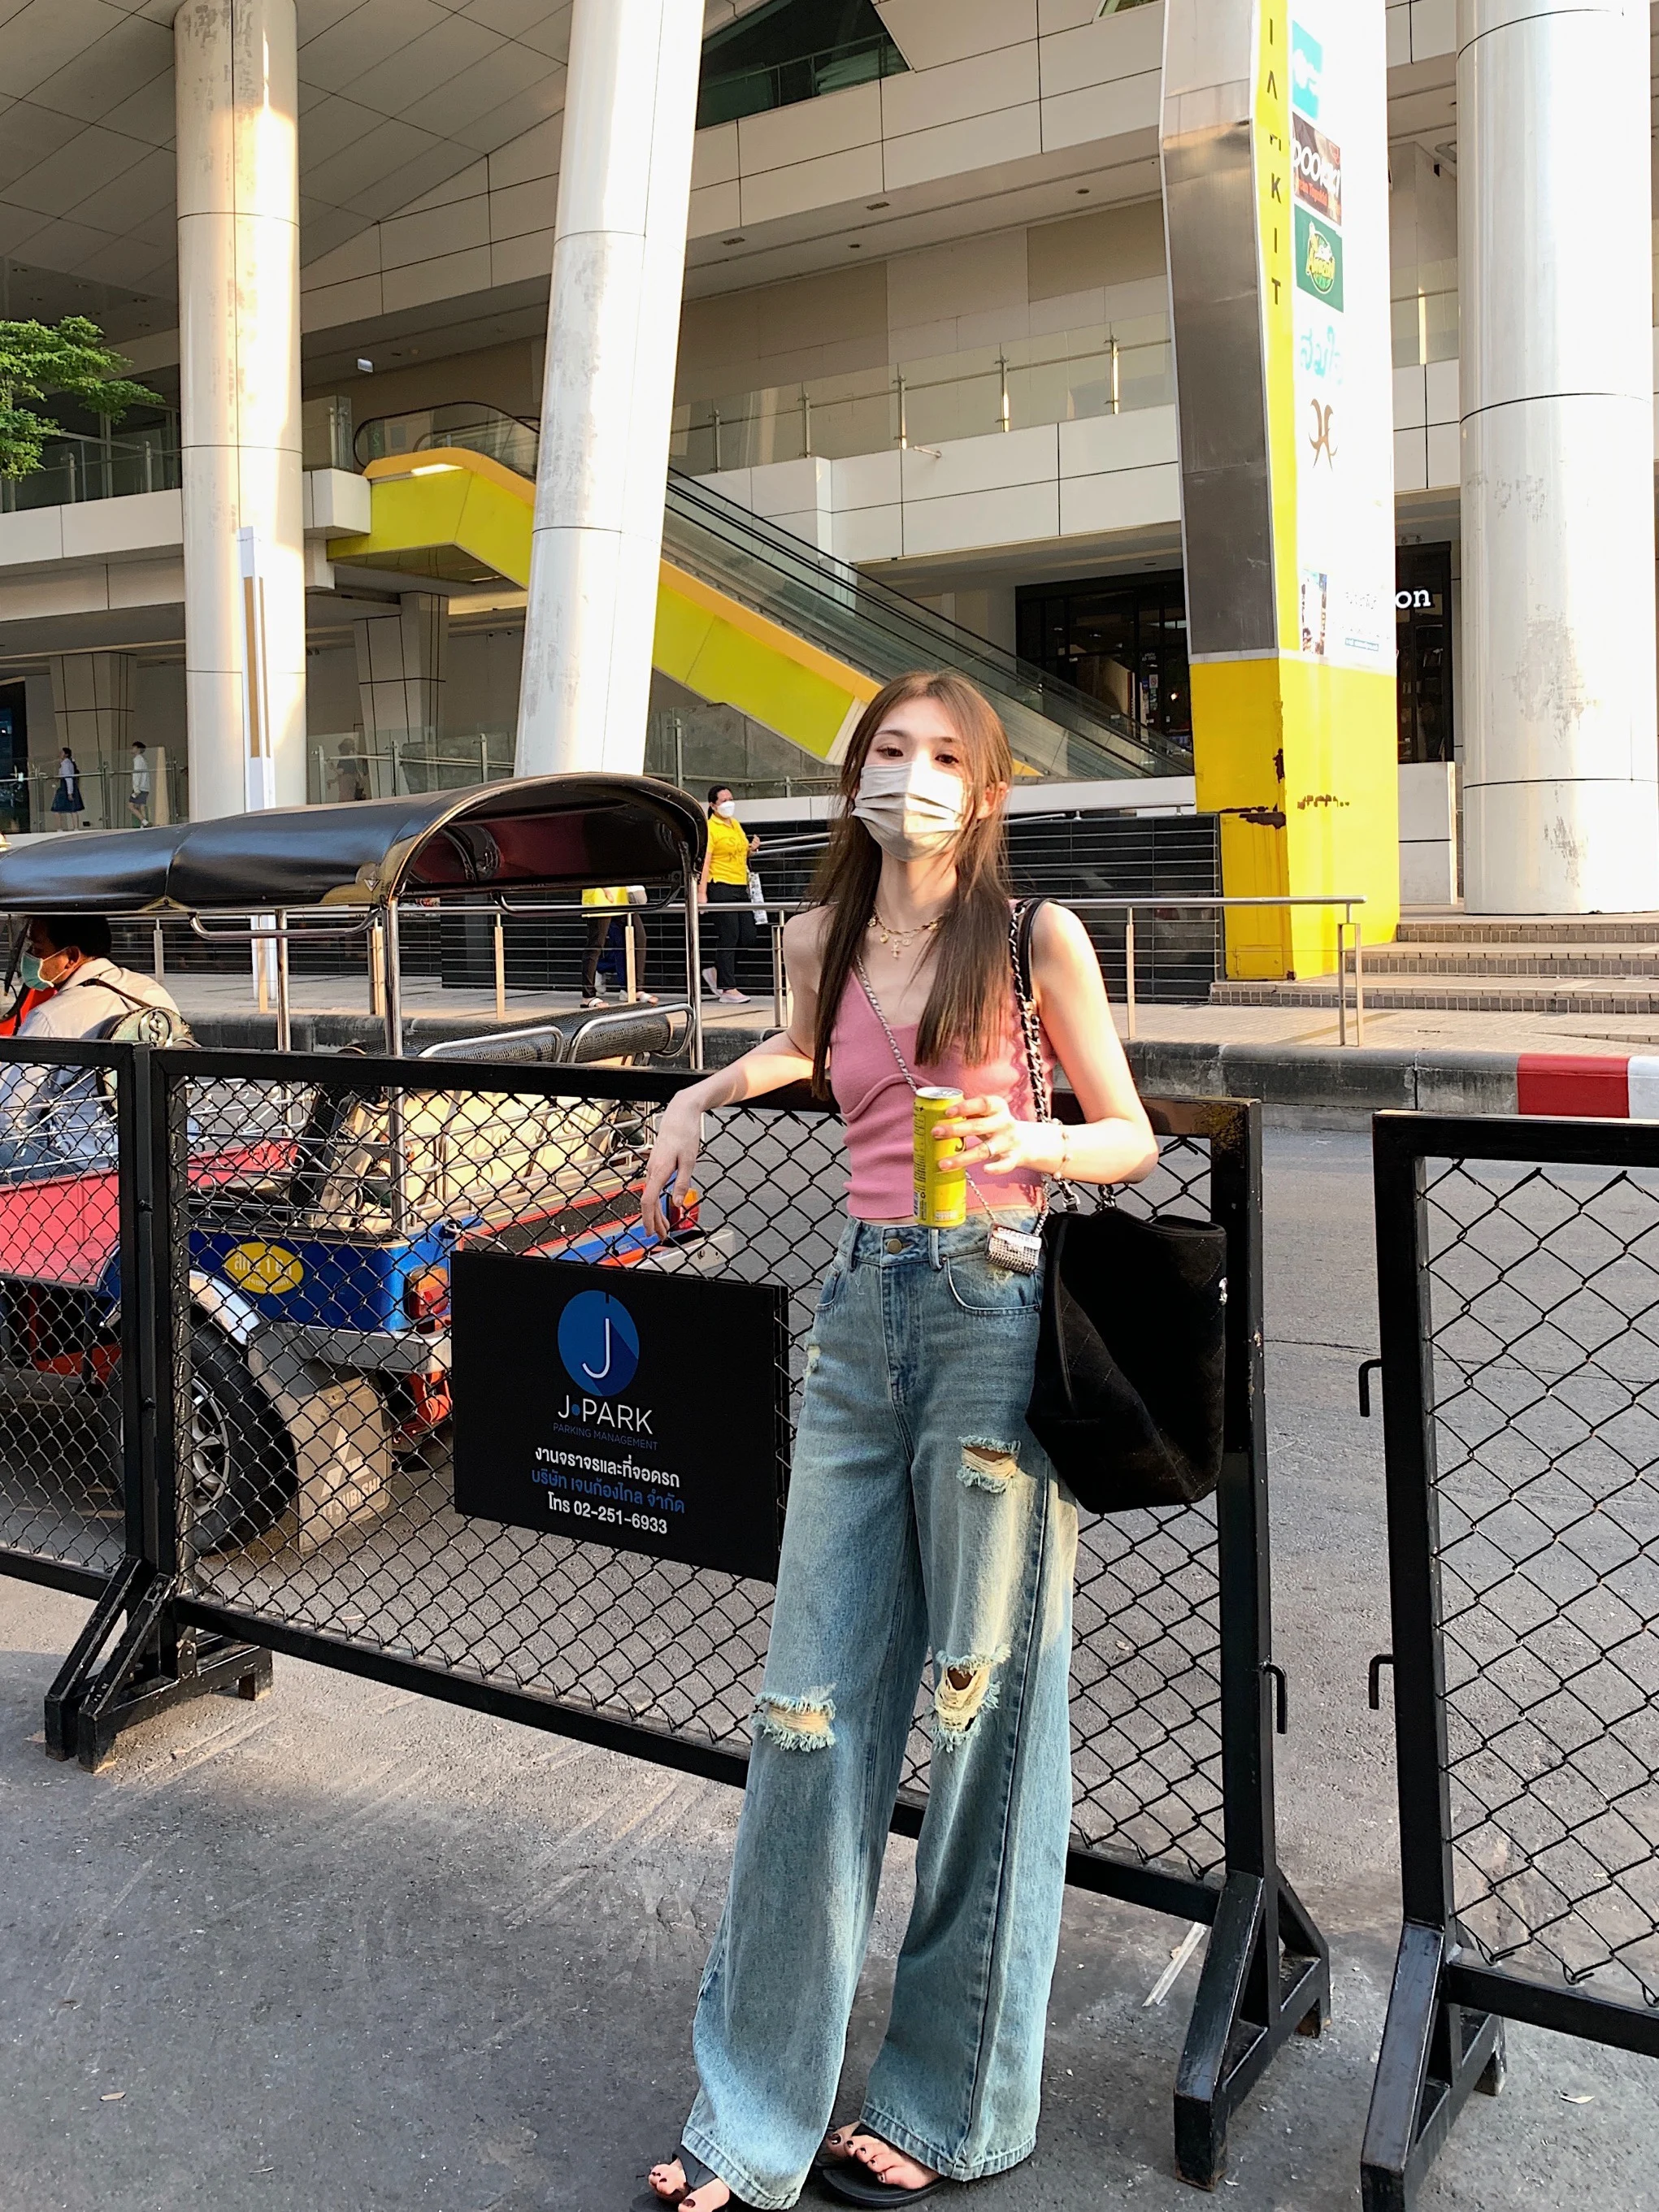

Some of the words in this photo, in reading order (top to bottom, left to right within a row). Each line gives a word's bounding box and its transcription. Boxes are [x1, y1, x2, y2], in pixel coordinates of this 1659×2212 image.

[553, 1422, 592, 1438] PARKING
[593, 1430, 658, 1451] MANAGEMENT
[535, 1447, 680, 1488] งานจราจรและที่จอดรถ
[531, 1468, 567, 1490] บริษัท
[647, 1488, 684, 1514] จำกัด
[547, 1490, 571, 1513] โทร
[574, 1502, 667, 1535] 02-251-6933
